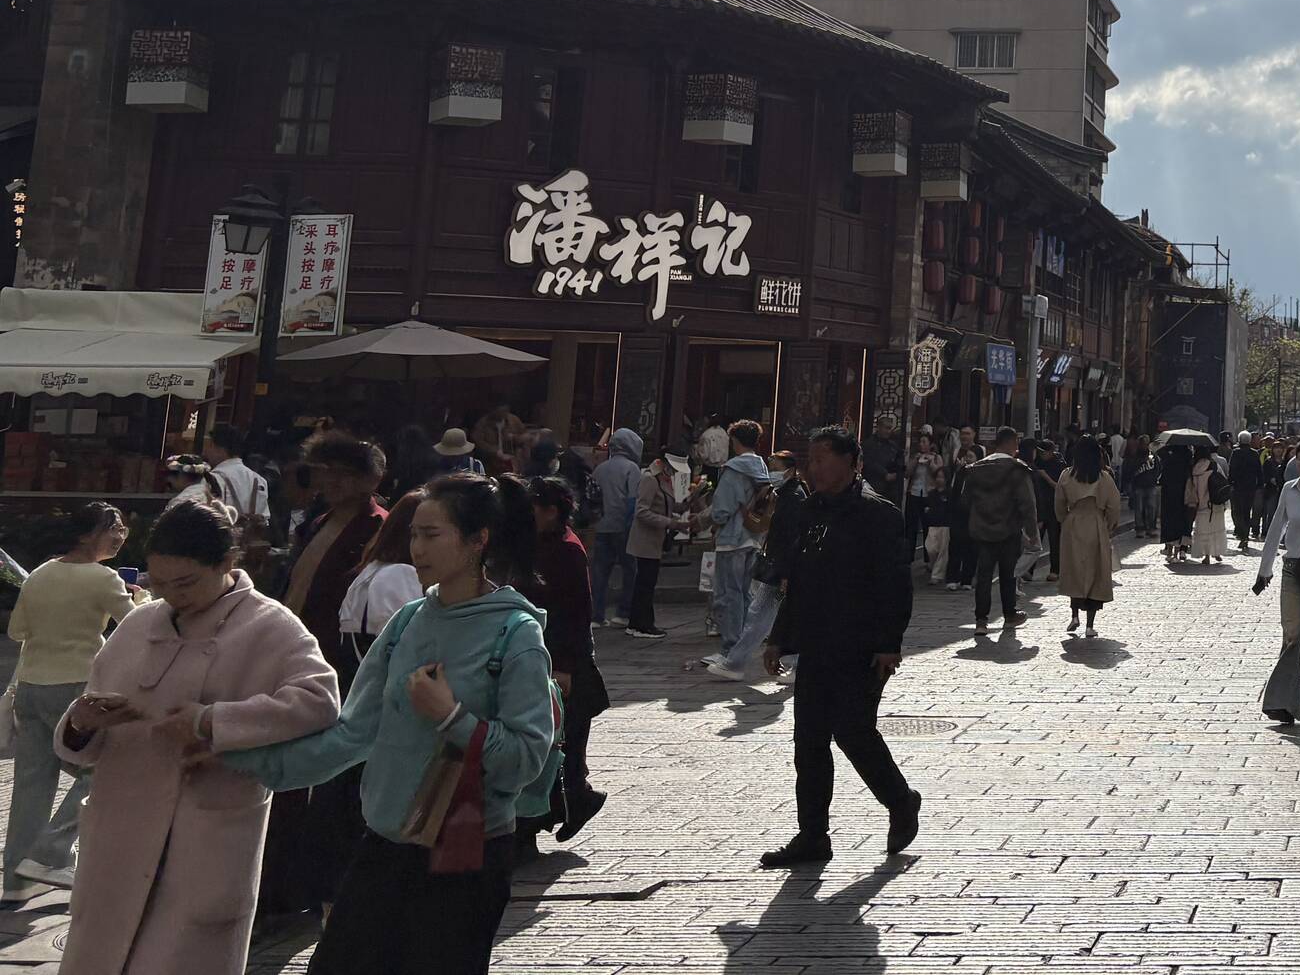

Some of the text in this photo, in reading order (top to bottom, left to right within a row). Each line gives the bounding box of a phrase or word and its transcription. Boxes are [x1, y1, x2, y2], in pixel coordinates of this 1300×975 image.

[509, 169, 753, 321] 潘祥记
[301, 258, 336, 273] 按摩
[299, 275, 334, 290] 足疗
[537, 266, 604, 297] 1941
[760, 278, 801, 306] 鲜花饼
